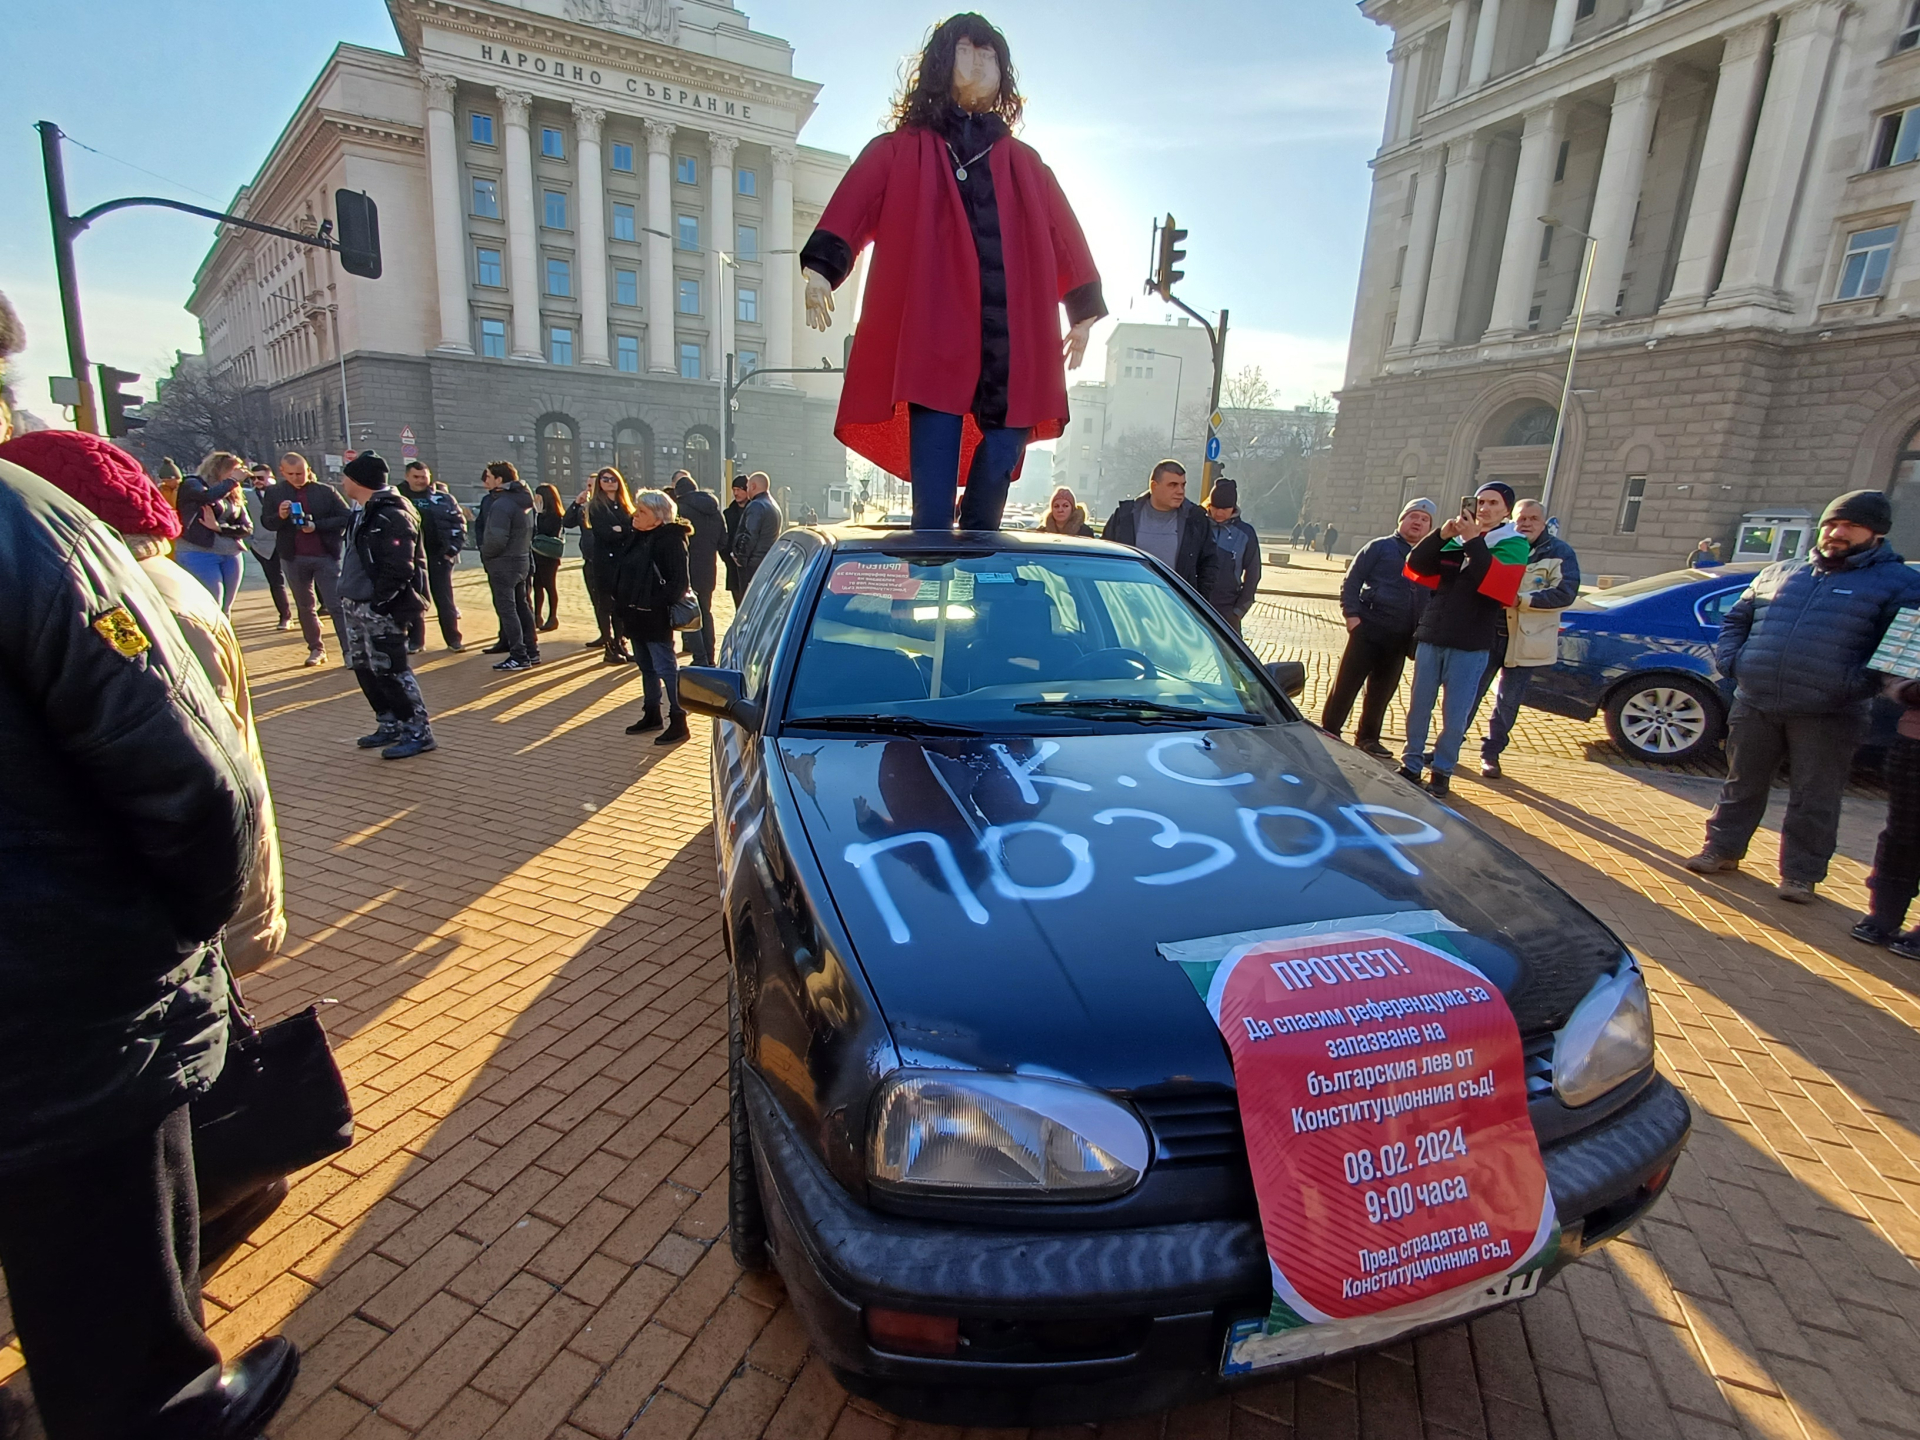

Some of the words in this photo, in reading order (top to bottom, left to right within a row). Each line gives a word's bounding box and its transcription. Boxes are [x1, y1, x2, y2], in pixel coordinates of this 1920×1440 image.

[481, 44, 602, 85] НАРОДНО
[626, 78, 751, 119] СЪБРАНИЕ
[1270, 948, 1412, 991] ПРОТЕСТ!
[1242, 1016, 1274, 1040] Да
[1274, 1007, 1346, 1034] спасим
[1345, 987, 1468, 1026] референдума
[1464, 984, 1491, 1002] за
[1325, 1027, 1421, 1059] запазване
[1423, 1021, 1446, 1042] на
[1306, 1059, 1417, 1096] българския
[1421, 1052, 1453, 1075] лев
[1455, 1048, 1475, 1068] от
[1291, 1083, 1455, 1134] Конституционния
[1458, 1069, 1495, 1097] съд!
[1365, 1182, 1414, 1223] 9:00
[1416, 1175, 1468, 1207] часа
[1341, 1247, 1479, 1299] Конституционния
[1482, 1238, 1511, 1259] съд
[1358, 1246, 1398, 1273] Пред
[1399, 1226, 1468, 1259] сградата
[1470, 1220, 1489, 1240] на
